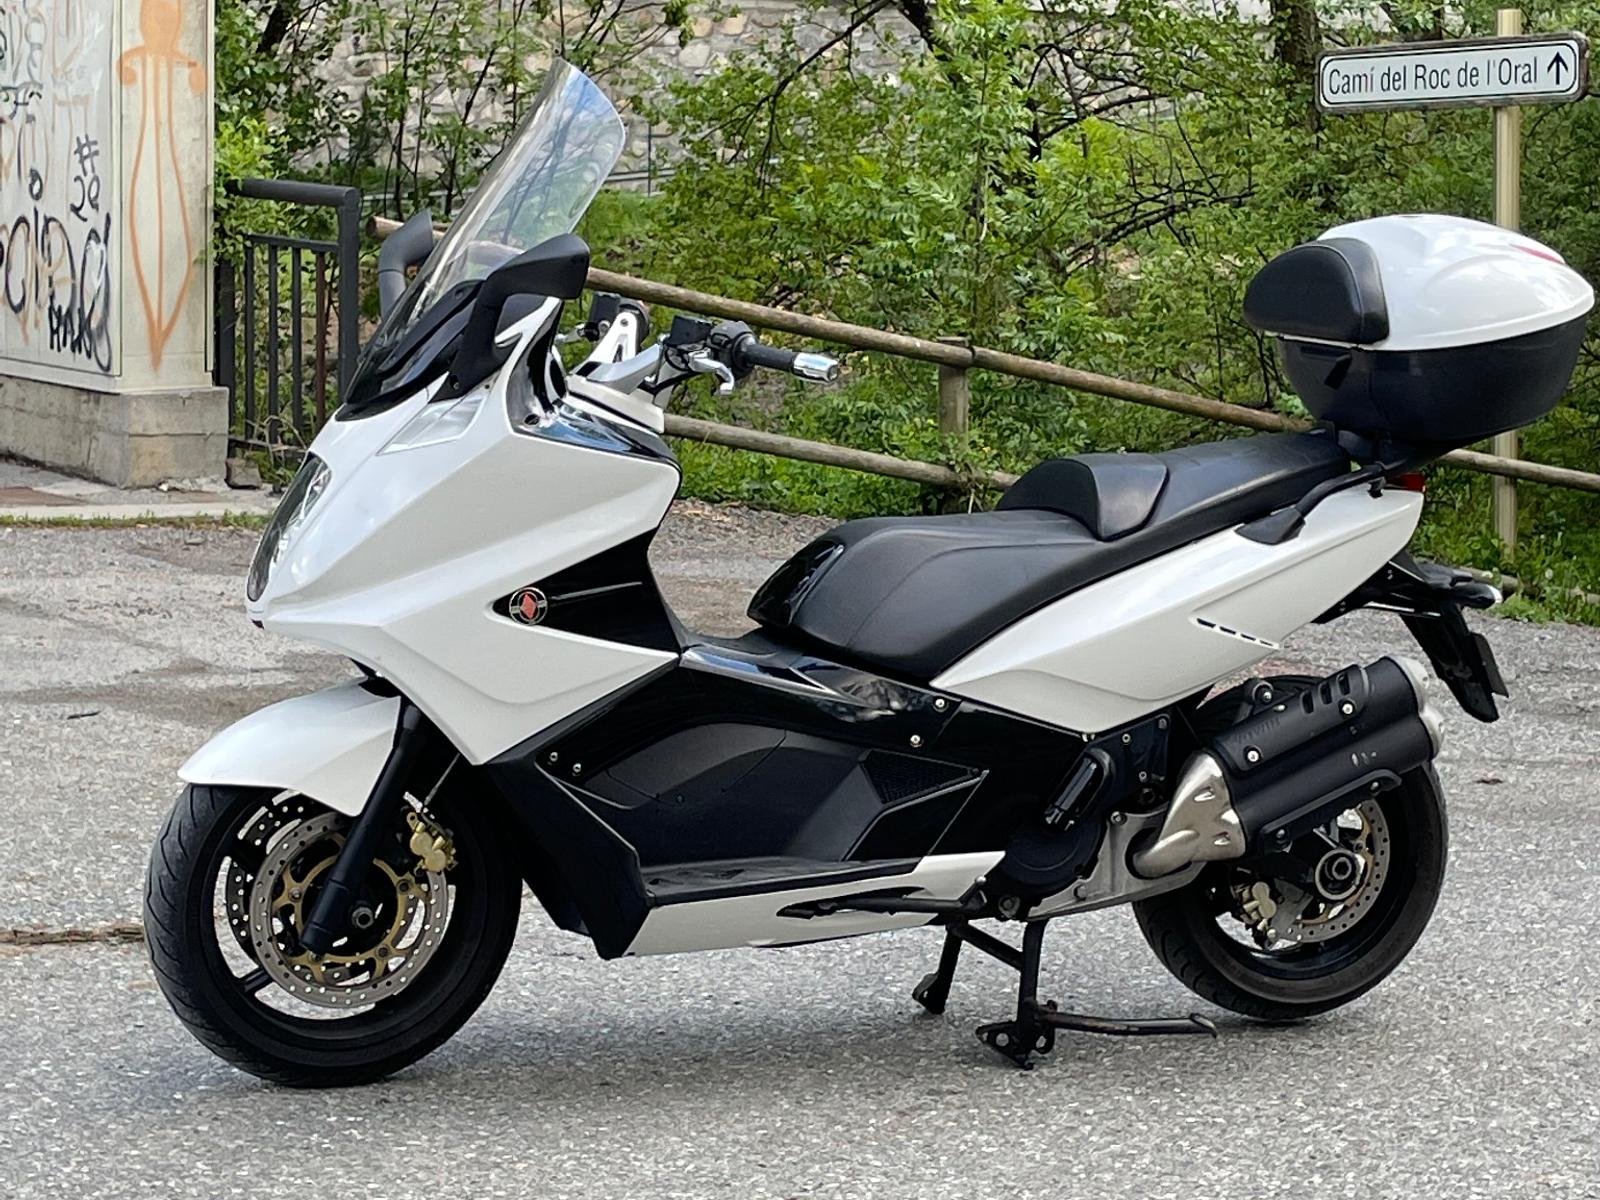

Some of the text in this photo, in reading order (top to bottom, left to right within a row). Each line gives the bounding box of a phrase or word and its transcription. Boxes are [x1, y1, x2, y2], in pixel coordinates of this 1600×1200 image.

[1329, 56, 1537, 95] Camí del Roc de l'Oral
